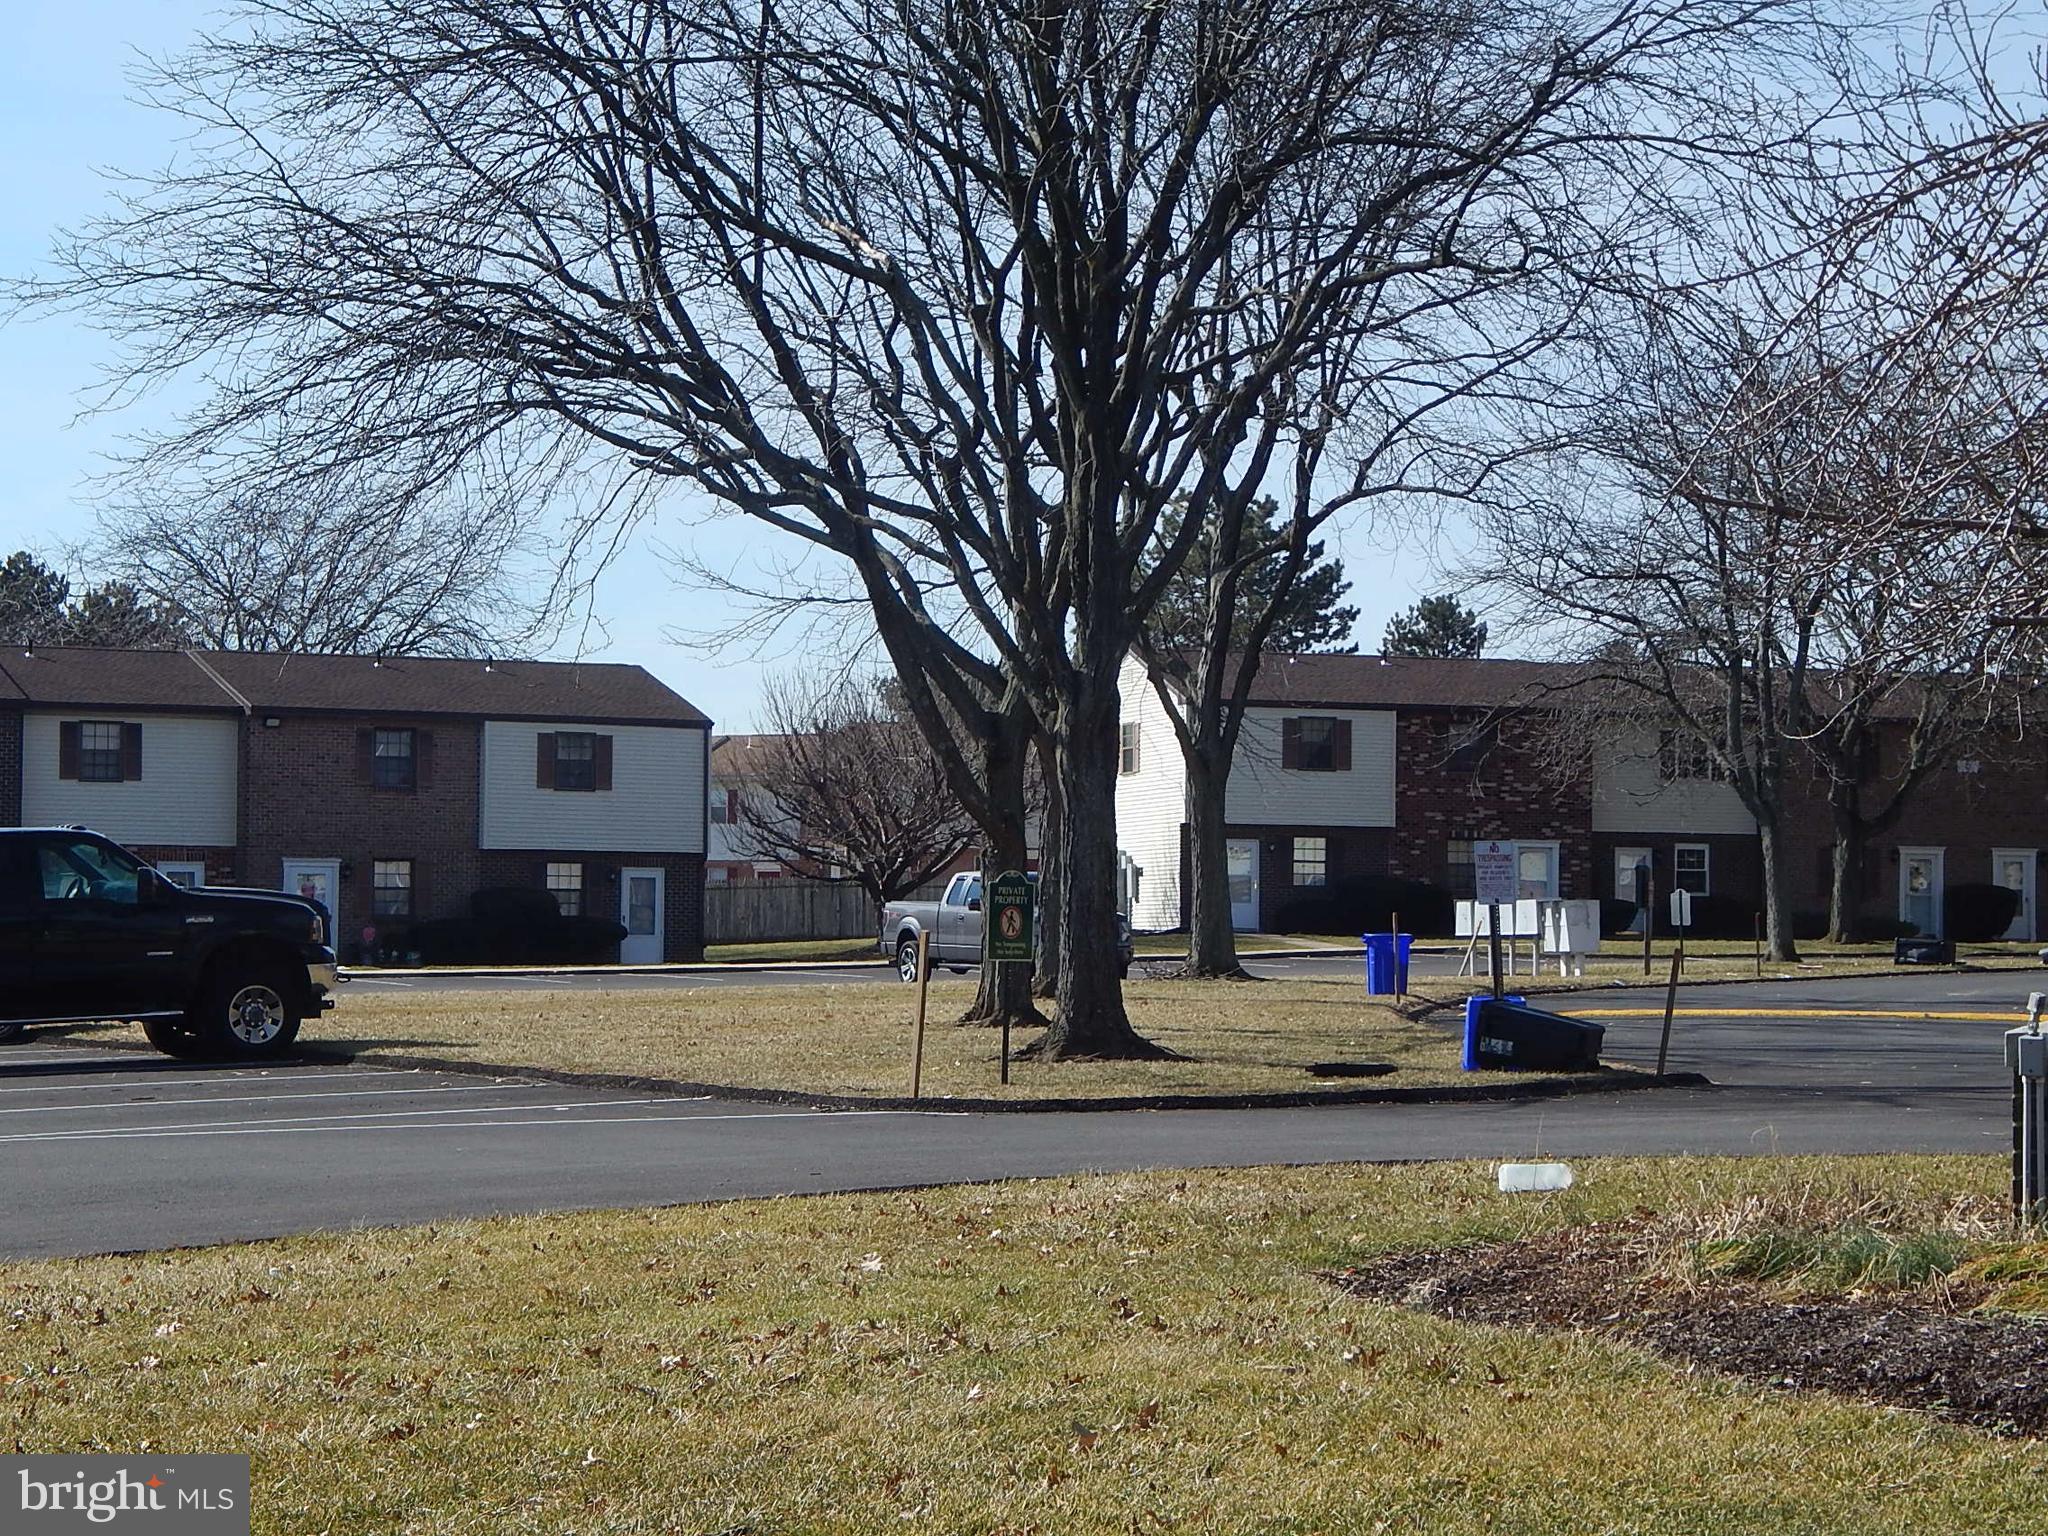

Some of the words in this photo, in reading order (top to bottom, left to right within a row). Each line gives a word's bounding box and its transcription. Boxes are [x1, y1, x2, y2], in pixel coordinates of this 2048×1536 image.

[1489, 845, 1499, 853] NO
[998, 886, 1025, 895] PRIVATE
[994, 896, 1028, 904] PROPERTY
